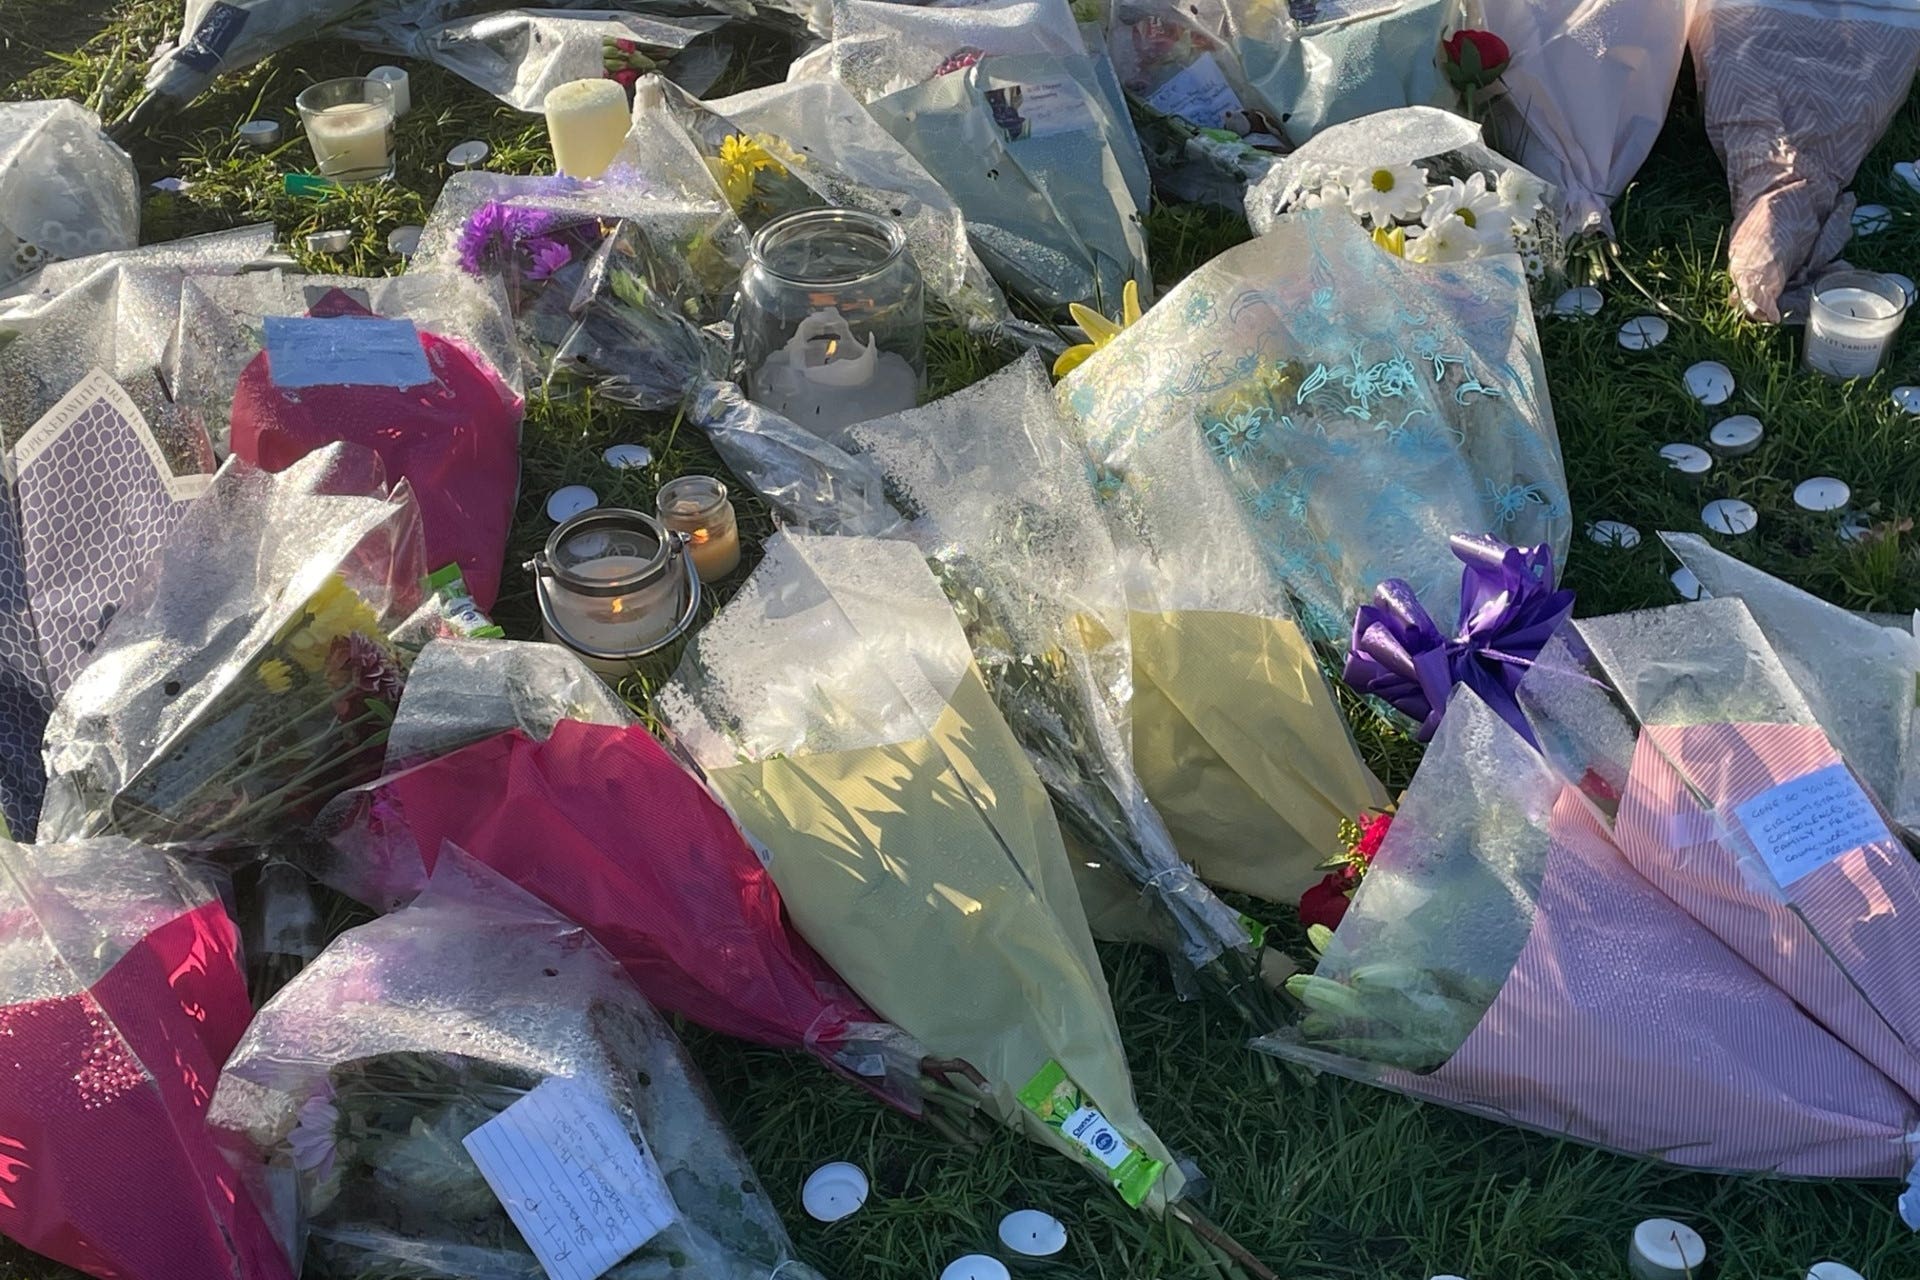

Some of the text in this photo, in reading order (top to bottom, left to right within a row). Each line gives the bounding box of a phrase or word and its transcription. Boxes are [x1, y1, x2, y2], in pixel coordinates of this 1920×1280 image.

[1841, 343, 1877, 351] VANILLA
[28, 411, 68, 451] PICKED
[65, 384, 98, 417] WITH
